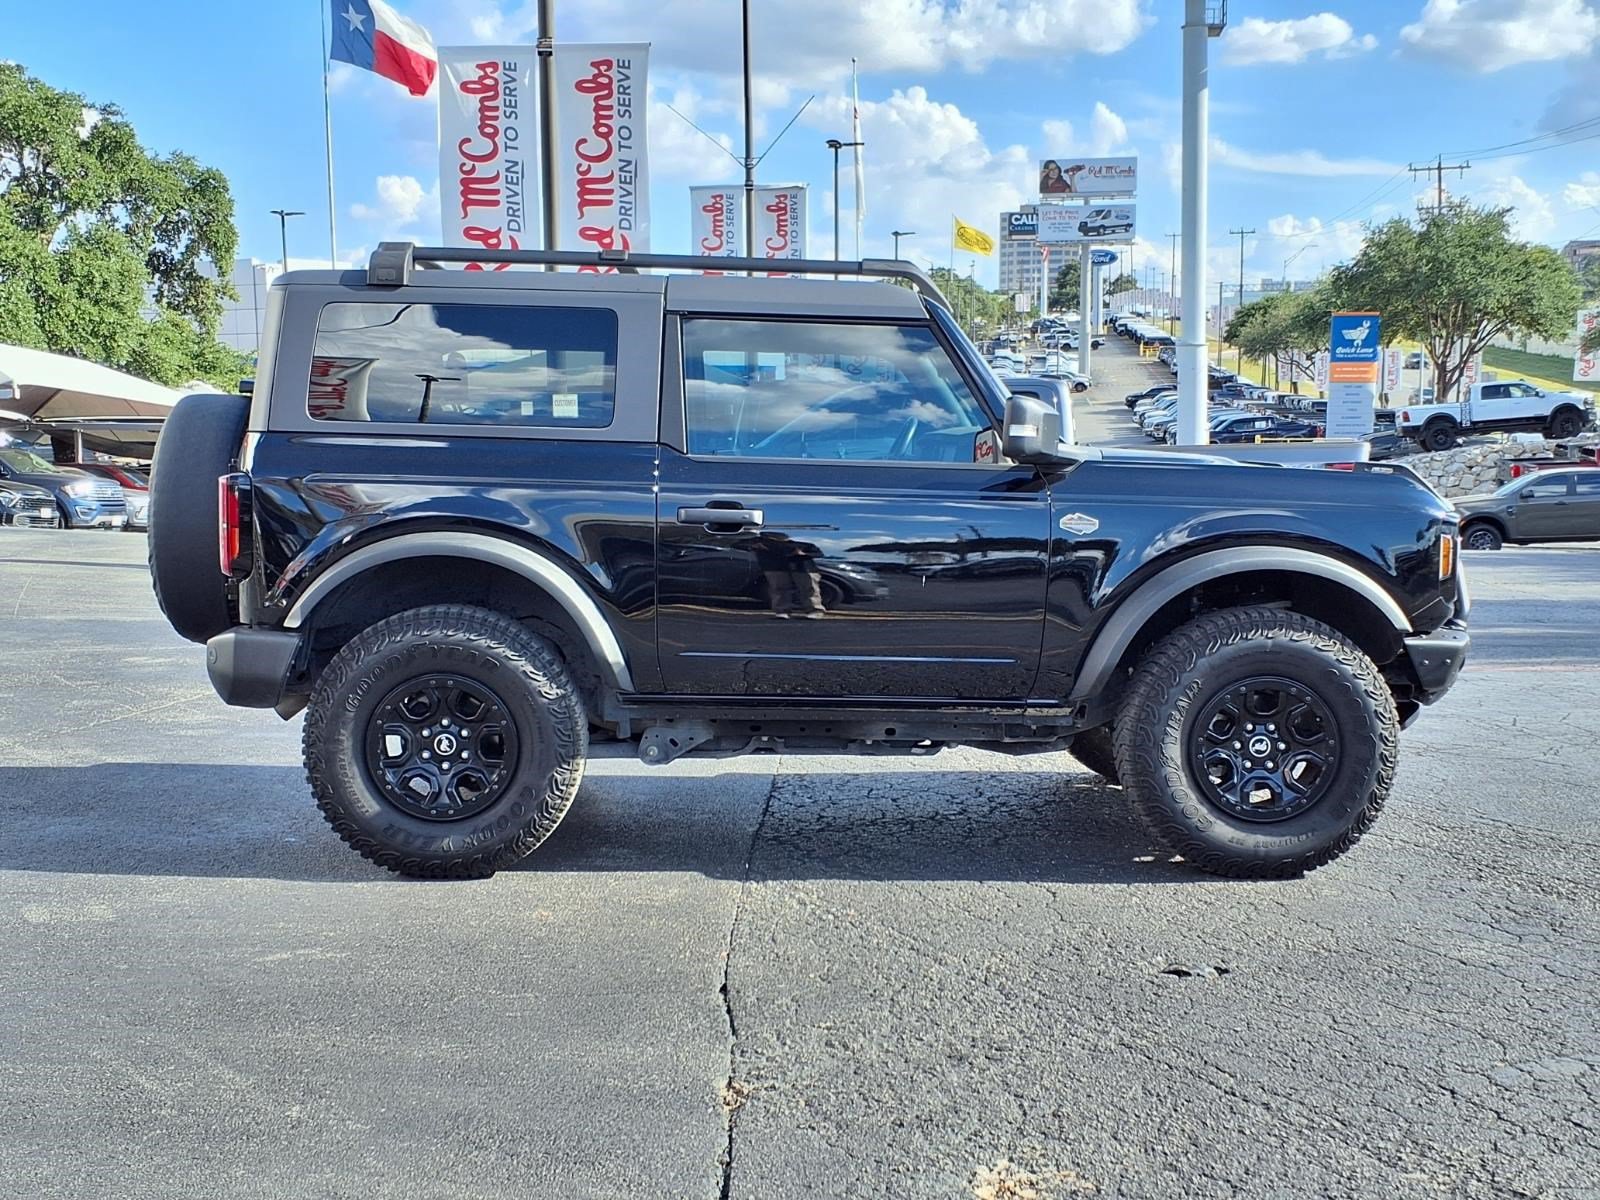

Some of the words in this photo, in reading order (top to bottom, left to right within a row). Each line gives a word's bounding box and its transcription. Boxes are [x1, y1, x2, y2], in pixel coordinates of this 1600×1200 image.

[503, 61, 519, 120] SERVE
[617, 58, 632, 119] SERVE
[459, 61, 500, 219] McCombs
[504, 126, 519, 152] TO
[575, 59, 614, 219] McCombs
[617, 125, 633, 152] TO
[504, 160, 521, 232] DRIVEN
[618, 159, 633, 230] DRIVEN
[726, 194, 734, 227] SERVE
[790, 193, 798, 226] SERVE
[726, 230, 734, 245] TO
[790, 230, 798, 245] TO
[1091, 252, 1111, 263] Ford
[1335, 346, 1356, 354] Quick
